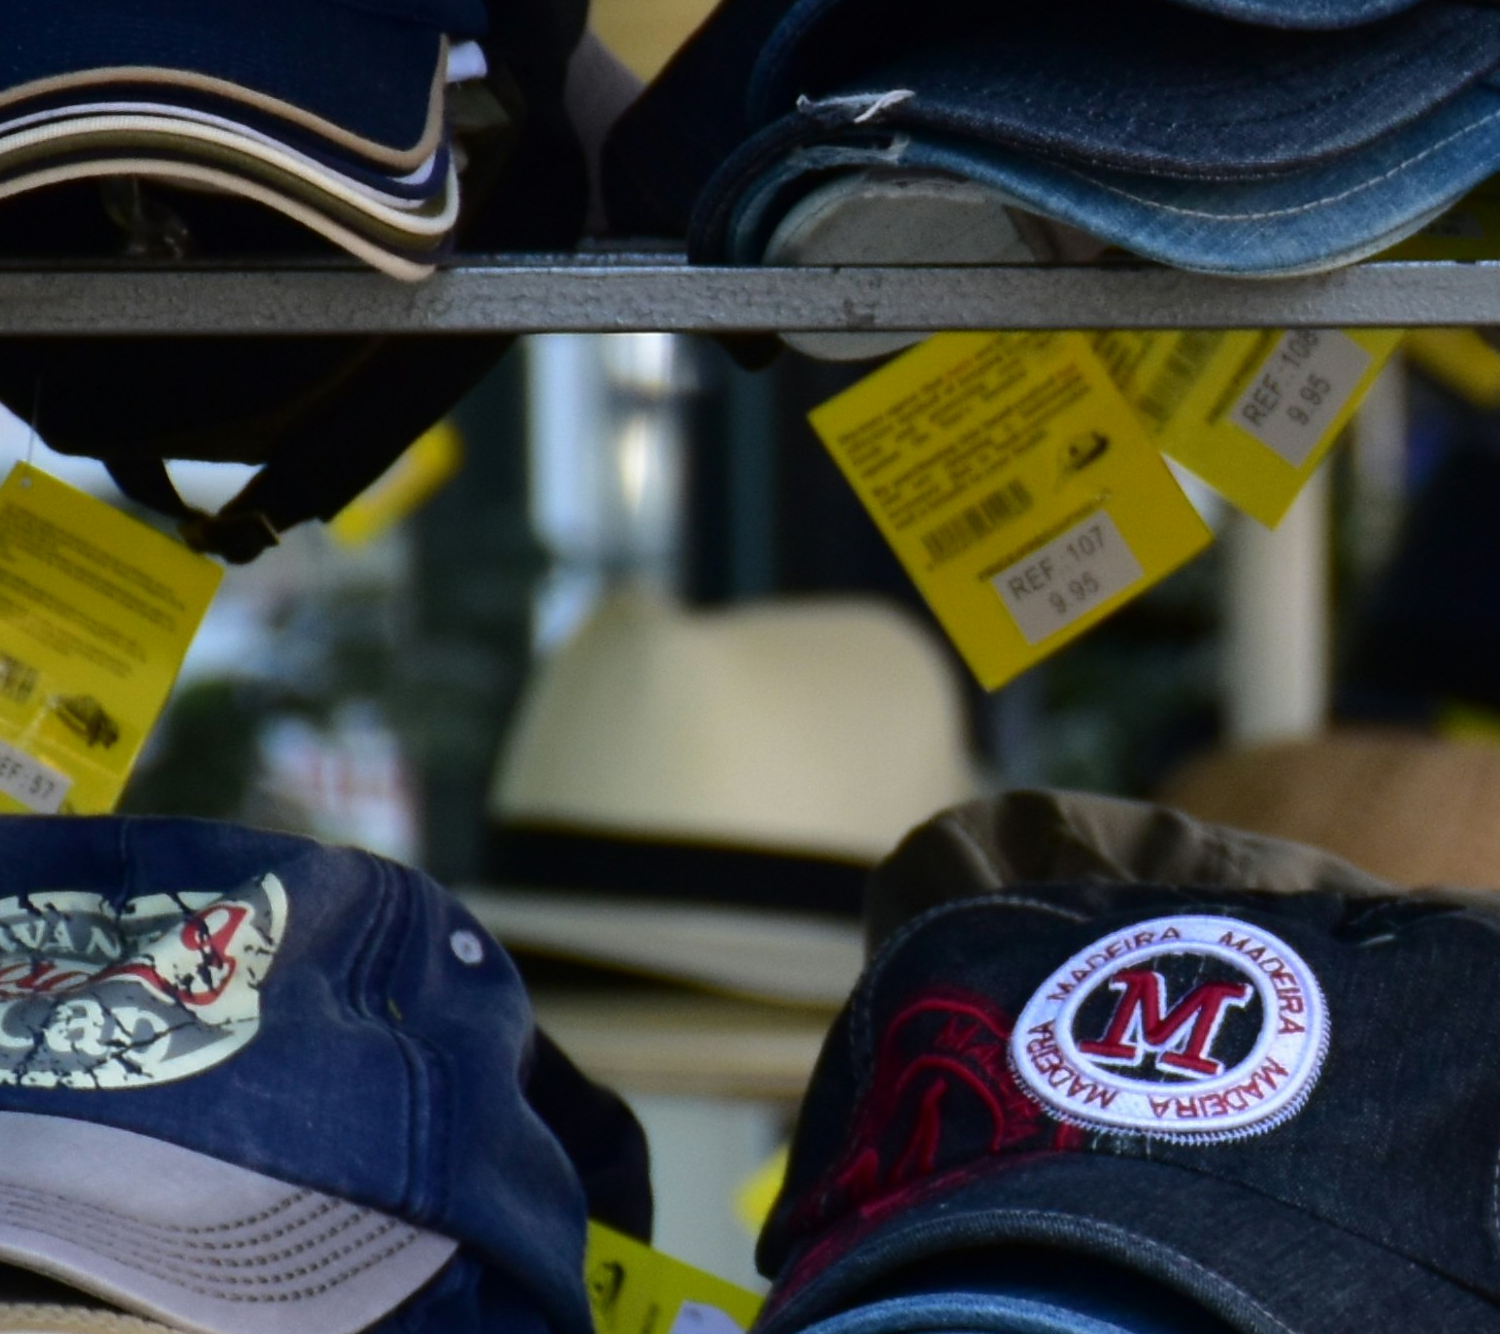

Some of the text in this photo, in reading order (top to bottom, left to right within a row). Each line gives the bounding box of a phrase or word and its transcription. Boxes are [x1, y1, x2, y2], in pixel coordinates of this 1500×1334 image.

[1046, 926, 1182, 1003] MADEIRA
[1216, 929, 1307, 1036] MADEIRA
[1025, 1019, 1118, 1111] MADEIRA
[1077, 967, 1254, 1077] M
[1148, 1054, 1289, 1120] MADEIRA
